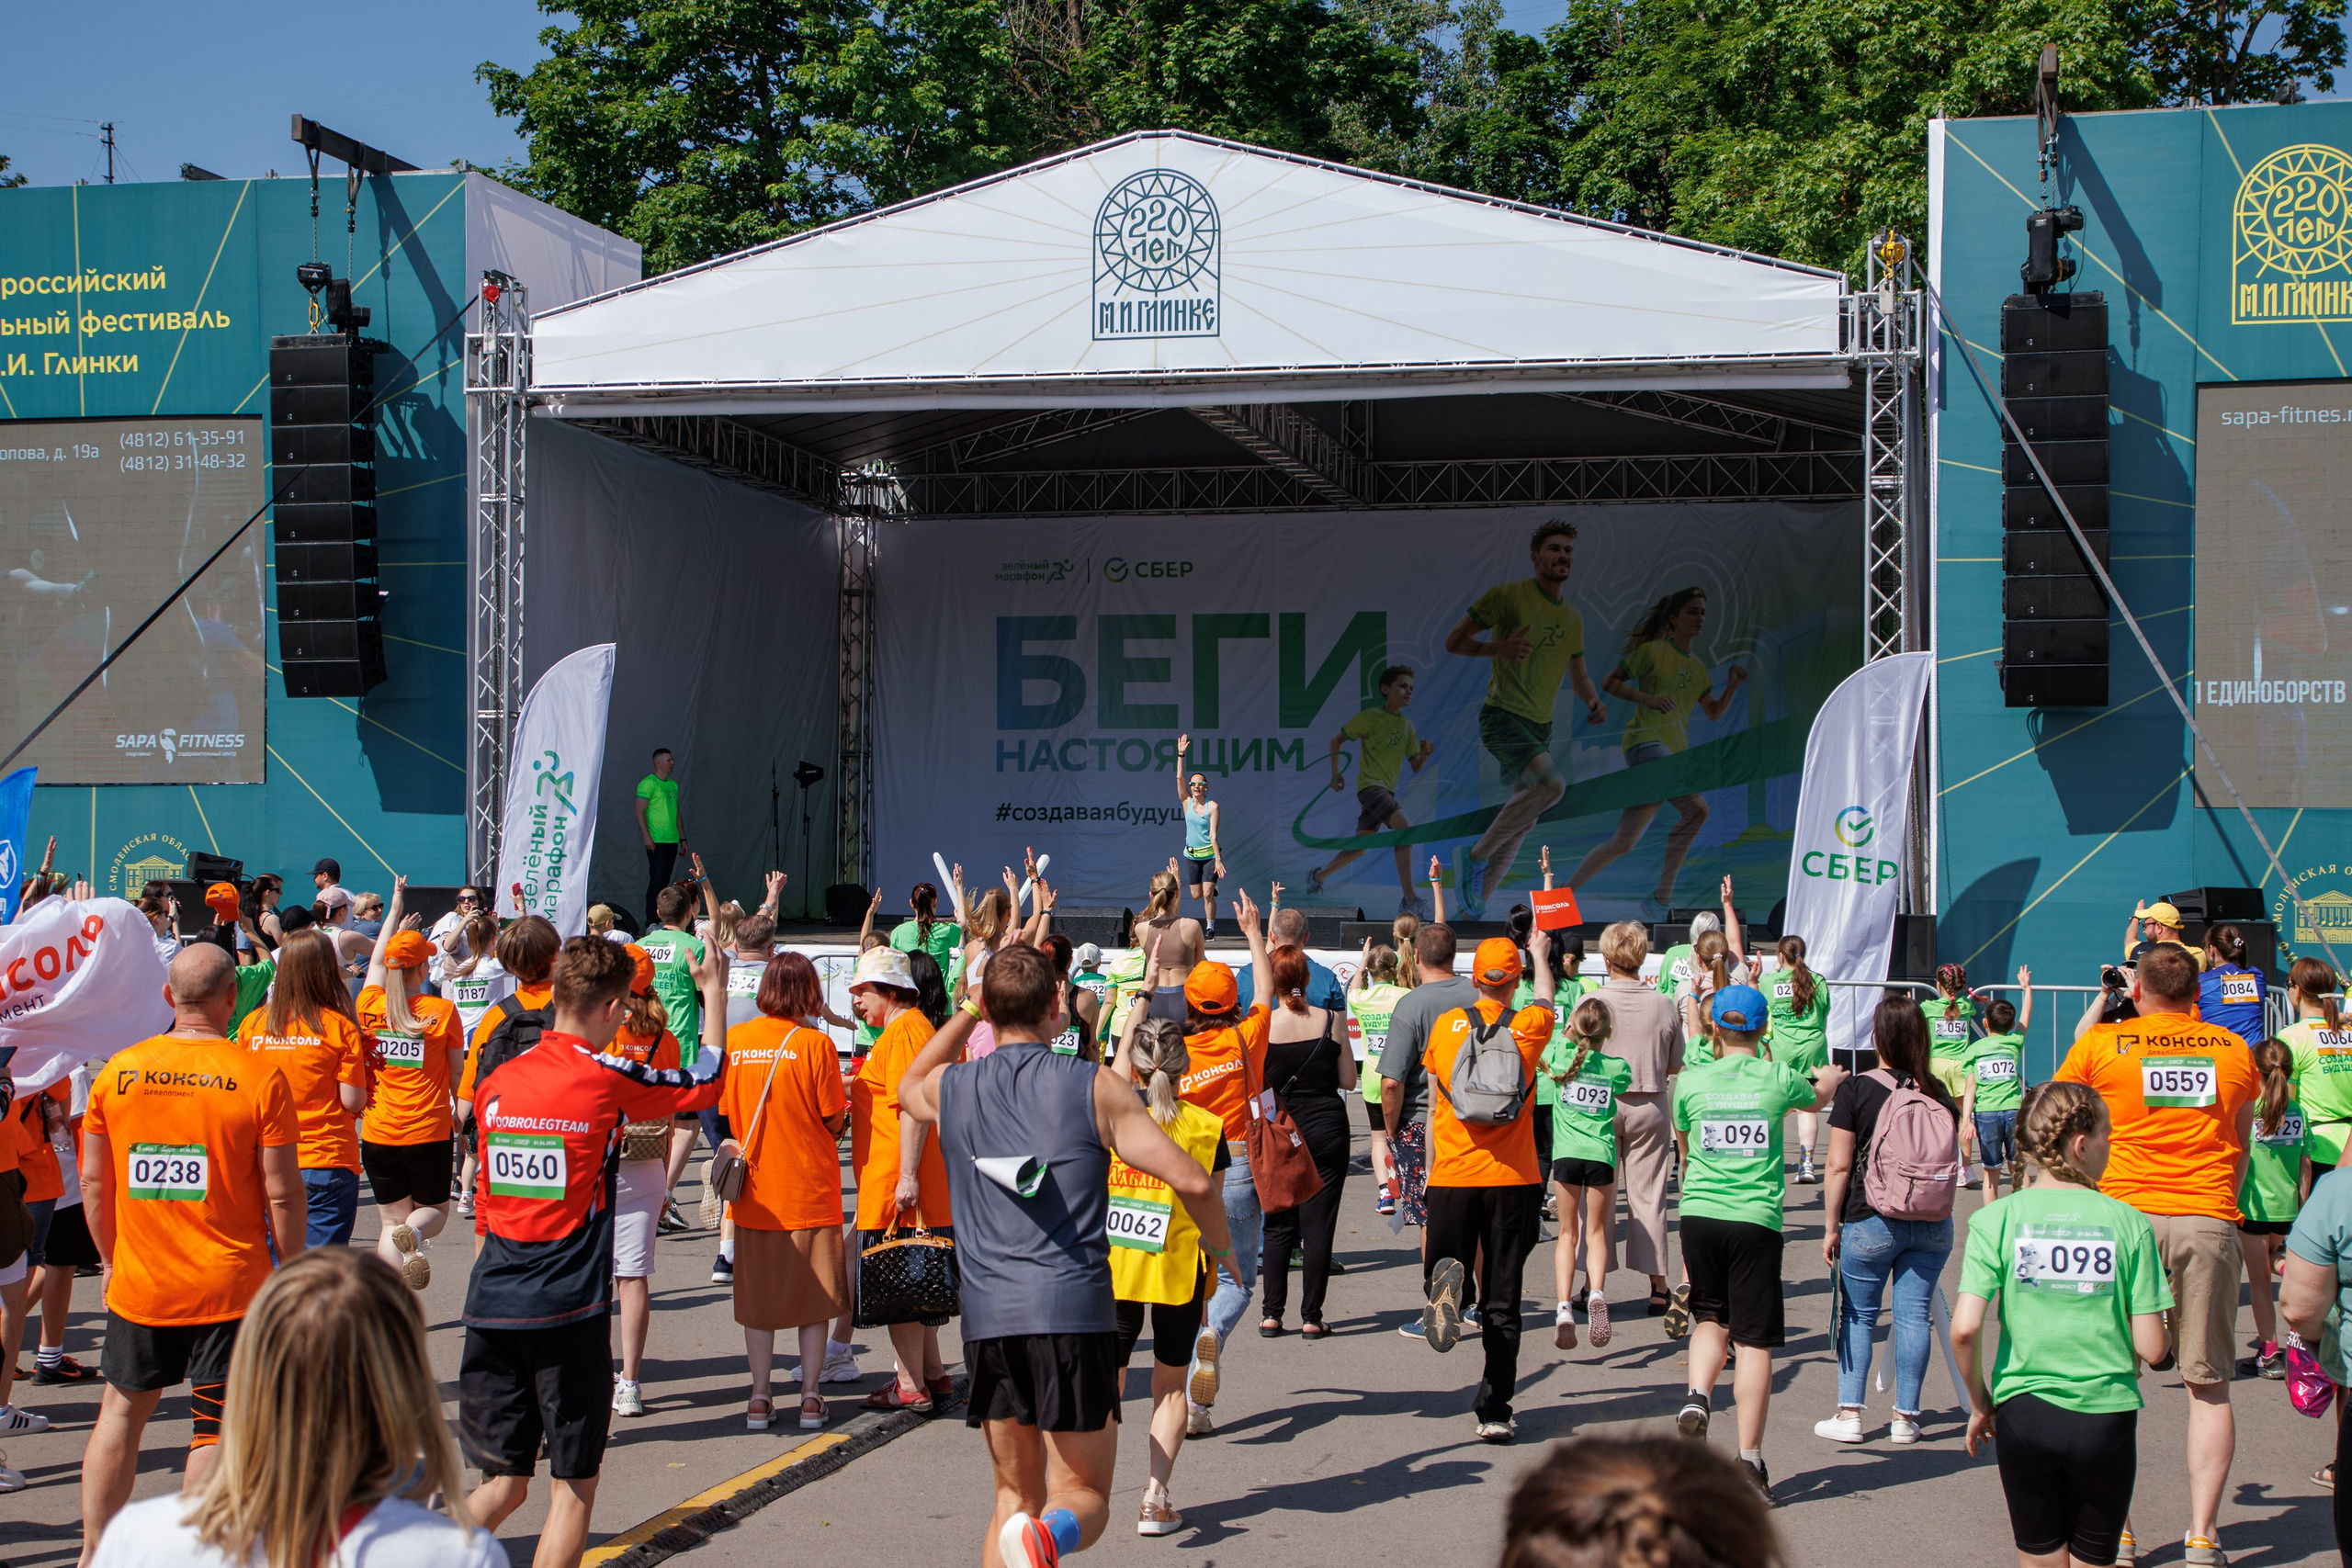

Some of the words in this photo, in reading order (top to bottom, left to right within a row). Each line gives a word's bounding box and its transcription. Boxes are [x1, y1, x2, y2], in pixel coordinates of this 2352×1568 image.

[2273, 175, 2340, 219] 220
[1128, 198, 1187, 238] 220
[2277, 216, 2335, 245] лет
[1132, 237, 1183, 265] лет
[1, 265, 166, 300] российский
[1, 310, 71, 336] ьный
[80, 309, 231, 338] фестиваль
[44, 352, 139, 376] Глинки
[119, 432, 170, 450] (4812)
[174, 430, 245, 446] 61-35-91
[54, 447, 67, 462] д.
[119, 456, 170, 473] (4812)
[174, 453, 246, 470] 31-48-32
[1001, 558, 1050, 571] зелёный
[1135, 561, 1194, 578] СБЕР
[995, 571, 1046, 583] марафон
[996, 611, 1387, 731] БЕГИ
[2207, 680, 2346, 706] ЕДИНОБОРСТВ
[115, 734, 157, 749] SAPA
[178, 734, 245, 749] FITNESS
[996, 737, 1305, 778] НАСТОЯЩИМ
[995, 801, 1186, 826] #создаваябудущ
[108, 832, 157, 892] СМОЛЕНСКАЯ
[522, 805, 548, 908] зелёный
[542, 816, 568, 925] марафон
[1802, 851, 1898, 886] СБЕР
[0, 914, 105, 1002] СОЛЬ
[458, 987, 486, 1000] 0187
[1777, 985, 1792, 996] 02
[2222, 982, 2255, 996] 0084
[1361, 1012, 1392, 1021] СОЗДАВ
[1947, 1022, 1966, 1033] 054
[379, 1040, 420, 1057] 0205
[626, 1044, 658, 1053] КОНСО
[2146, 1035, 2232, 1048] КОНСОЛЬ
[1193, 1059, 1244, 1083] КОНСОЛ
[1992, 1061, 2016, 1074] 072
[144, 1071, 238, 1091] КОНСОЛЬ
[2149, 1070, 2209, 1092] 0559
[143, 1089, 195, 1098] девелопмент
[1577, 1087, 1609, 1104] 093
[1724, 1124, 1767, 1145] 096
[135, 1159, 201, 1184] 0238
[495, 1152, 558, 1180] 0560
[1107, 1211, 1162, 1238] 0062
[2051, 1245, 2112, 1275] 098
